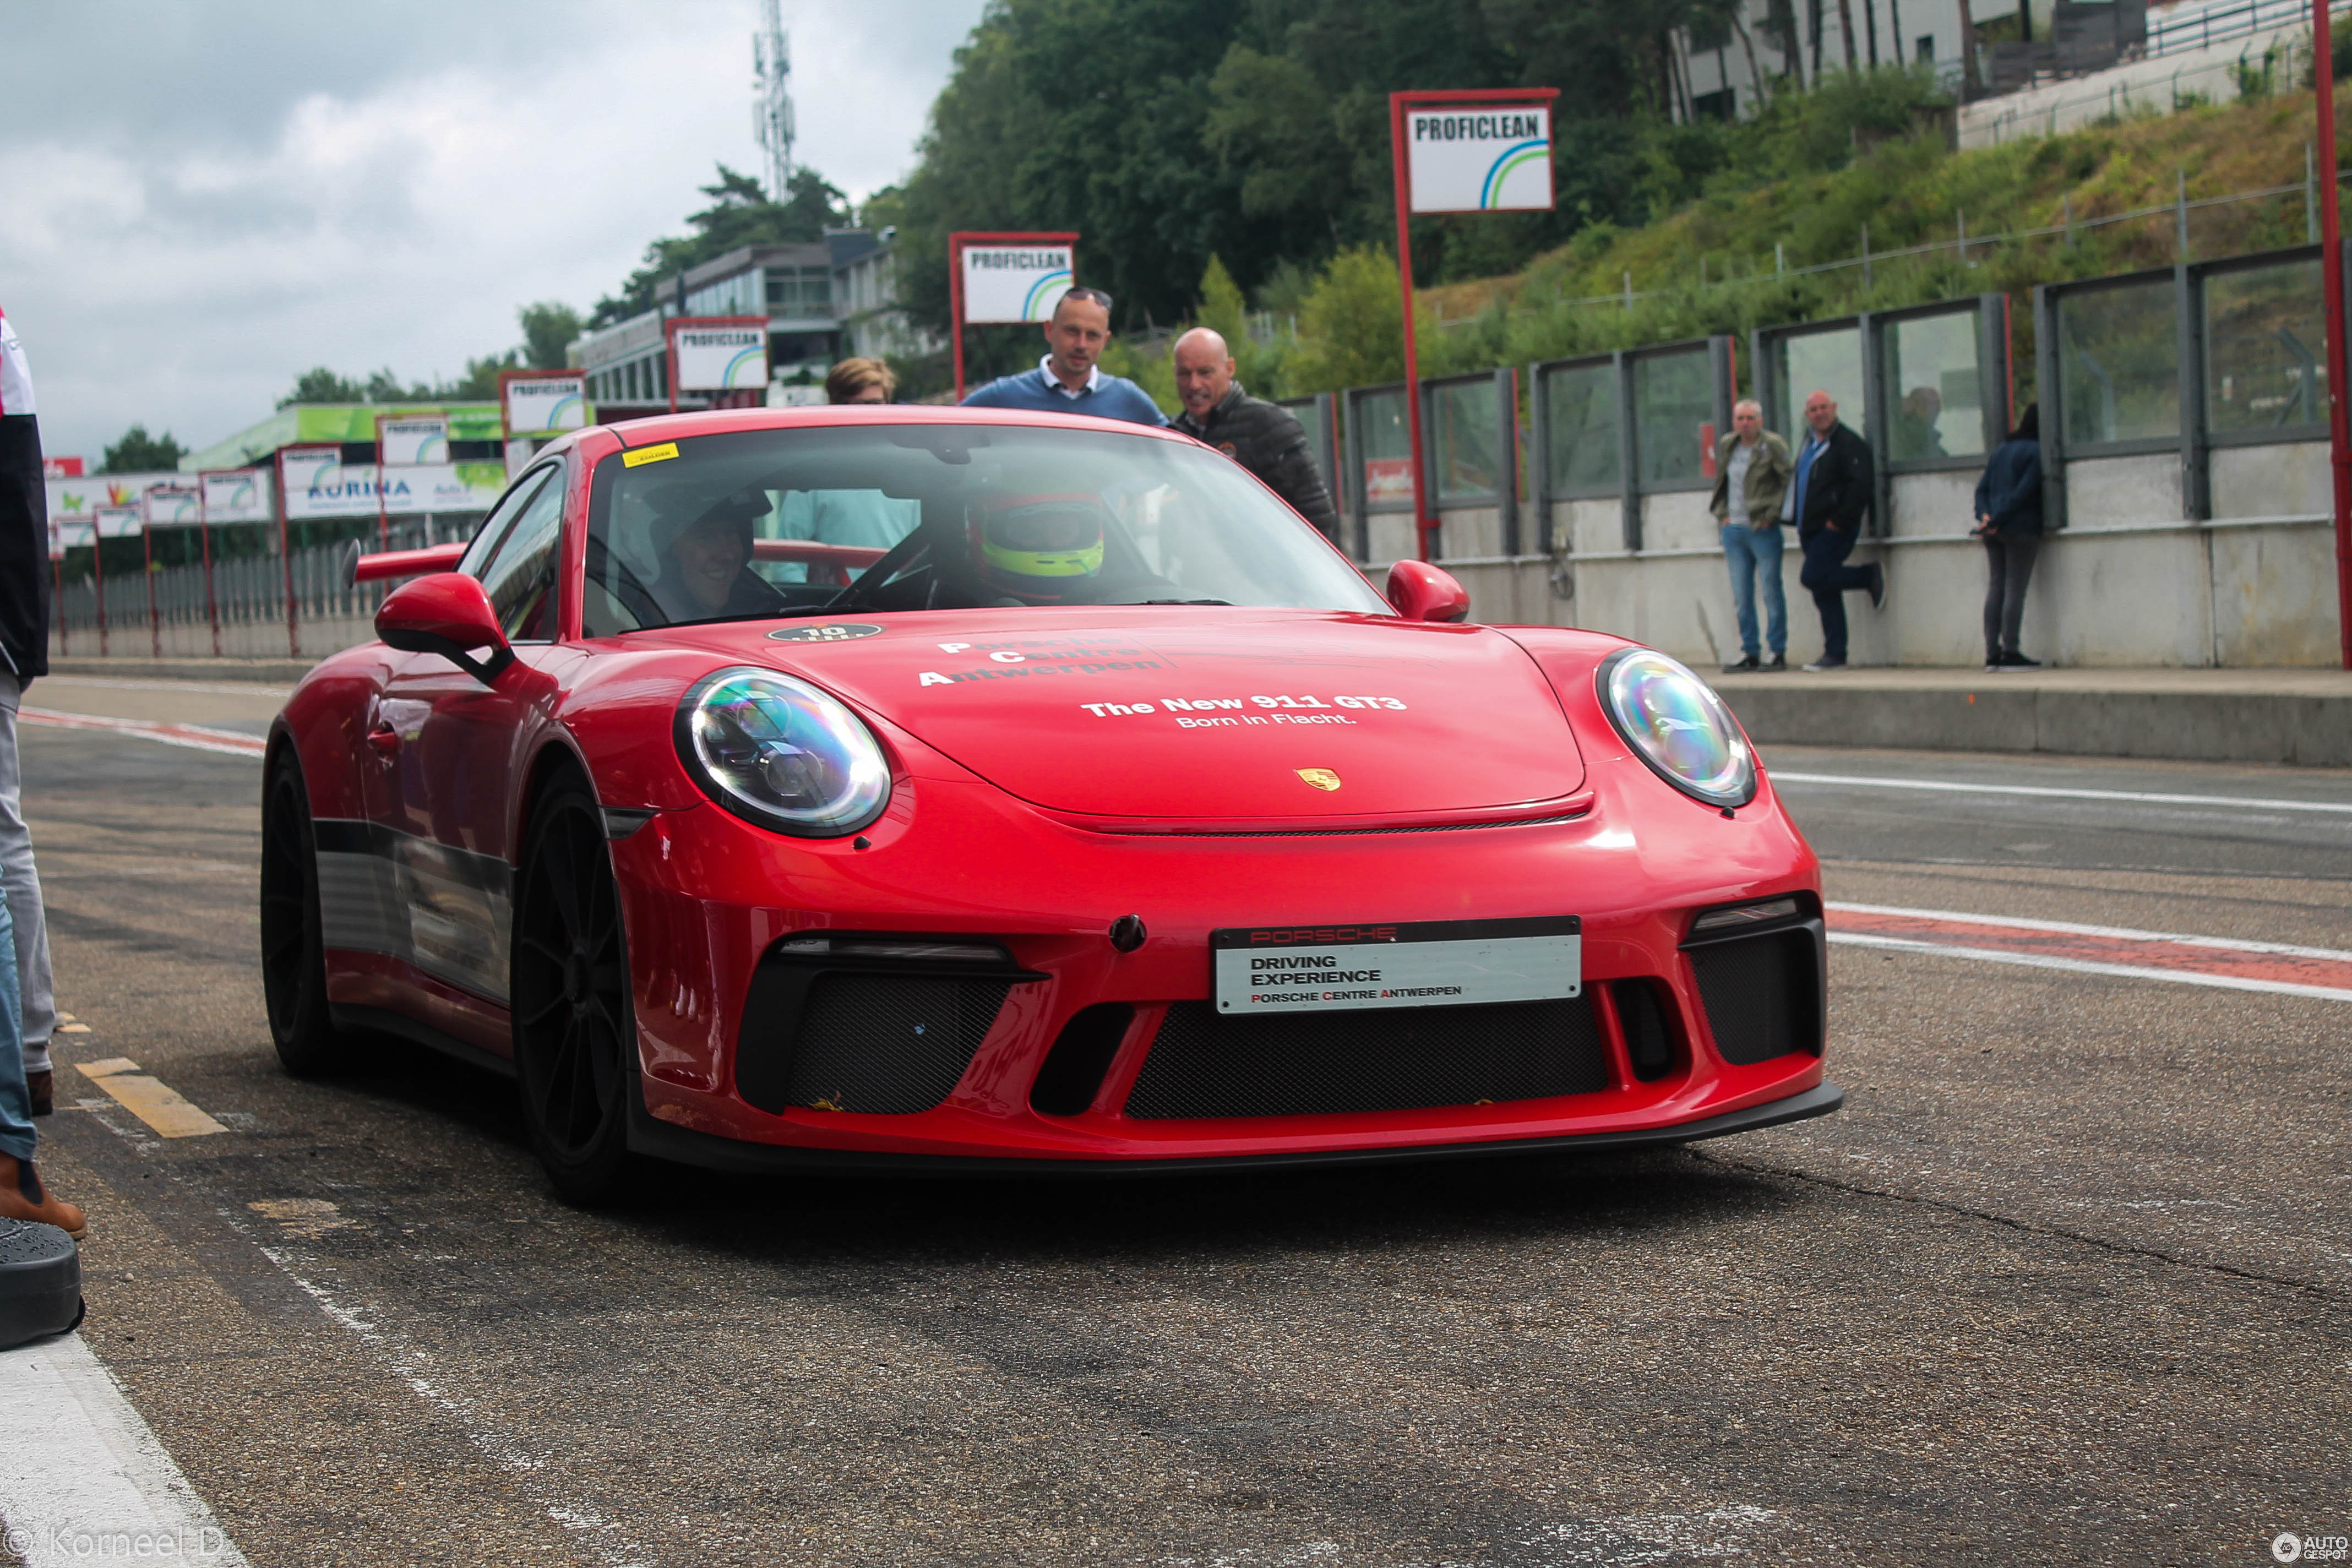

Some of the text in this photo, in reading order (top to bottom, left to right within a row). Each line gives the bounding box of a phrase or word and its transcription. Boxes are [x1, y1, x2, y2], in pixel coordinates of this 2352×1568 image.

[1415, 114, 1538, 141] PROFICLEAN
[971, 252, 1066, 269] PROFICLEAN
[802, 627, 847, 636] 10
[938, 636, 1123, 654] Porsche
[989, 647, 1141, 663] Centre
[918, 660, 1163, 687] Antwerpen
[1080, 695, 1407, 717] The New 911 GT3
[1175, 712, 1358, 729] Born in Flacht.
[1250, 927, 1398, 944] PORSCHE
[1250, 955, 1337, 971] DRIVING
[1250, 970, 1381, 987] EXPERIENCE
[1250, 986, 1462, 1004] PORSCHE CENTRE ANTWERPEN
